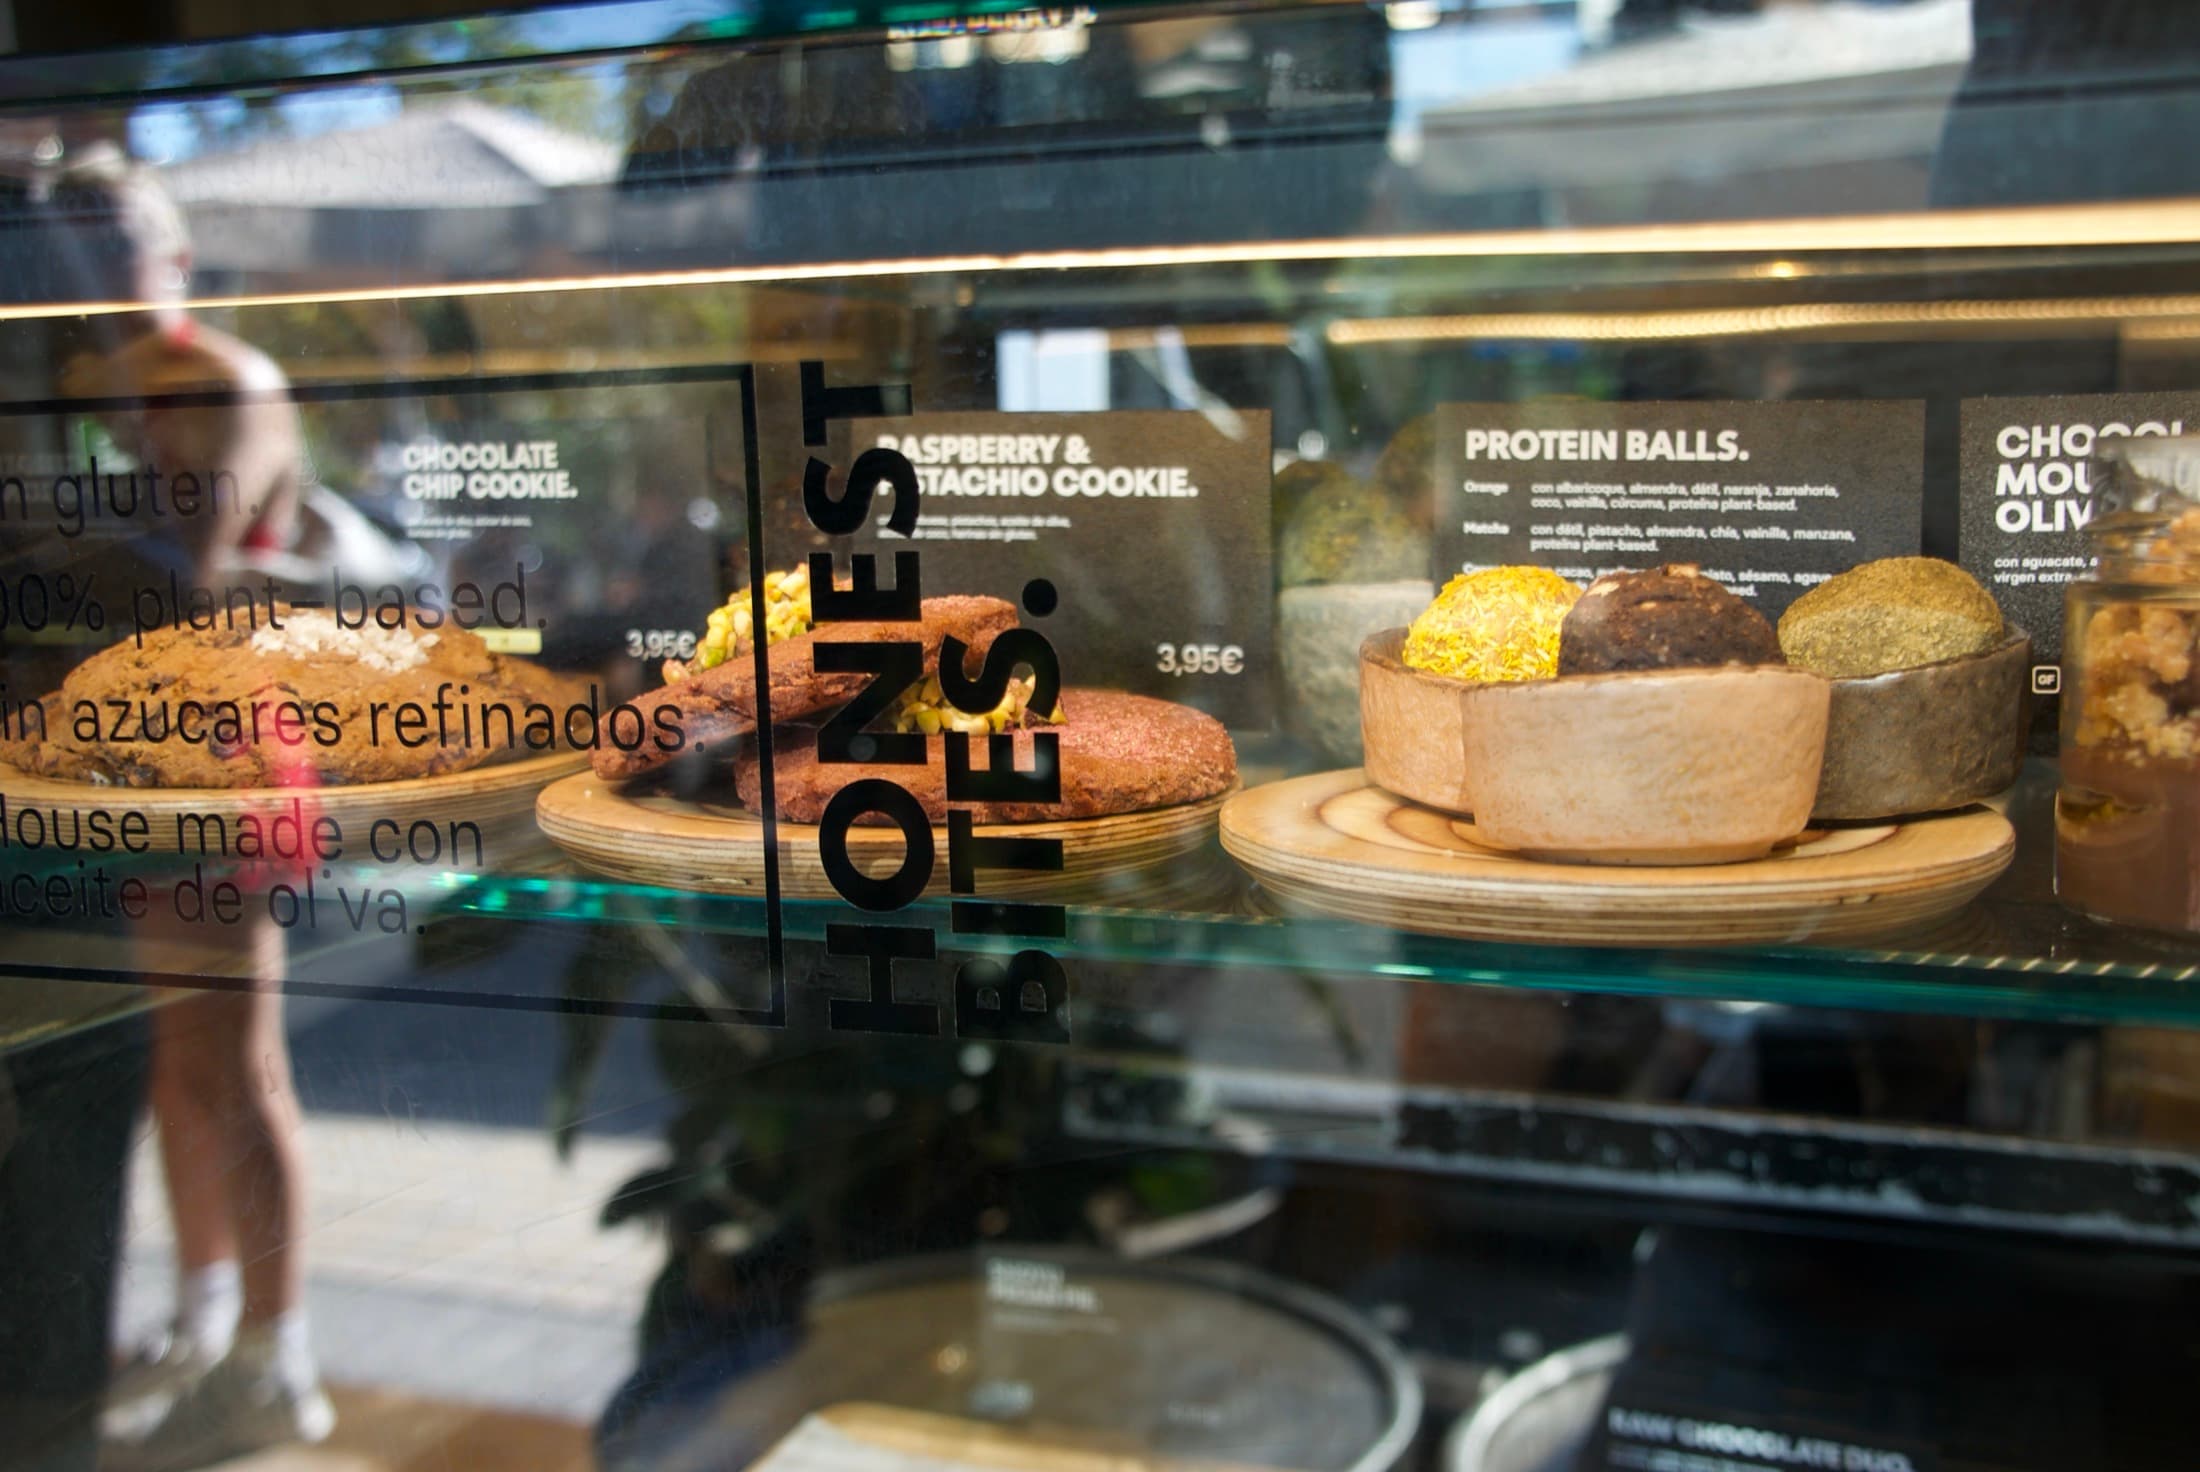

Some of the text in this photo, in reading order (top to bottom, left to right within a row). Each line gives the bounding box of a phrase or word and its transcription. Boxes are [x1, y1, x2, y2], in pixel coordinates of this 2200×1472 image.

[402, 441, 558, 471] CHOCOLATE
[1064, 435, 1091, 464] &
[1465, 429, 1749, 461] PROTEIN BALLS.
[54, 456, 259, 537] gluten.
[404, 471, 578, 500] CHIP COOKIE.
[877, 466, 1199, 499] STACHIO COOKIE.
[1531, 483, 1554, 494] con
[1629, 481, 1689, 497] almendra,
[1721, 497, 1798, 513] plant-based.
[1530, 524, 1554, 535] con
[1994, 557, 2018, 568] con
[2022, 555, 2086, 571] aguacate,
[1994, 571, 2036, 586] virgen
[625, 629, 697, 661] 3,95€
[1156, 642, 1244, 676] 3,95€
[800, 360, 941, 1035] HONEST
[72, 683, 343, 746] azúcares
[369, 683, 706, 752] refinados.
[938, 578, 1071, 1045] BITES.
[177, 798, 343, 861] made
[370, 817, 484, 867] con
[0, 859, 147, 919] ceite
[174, 863, 242, 925] de
